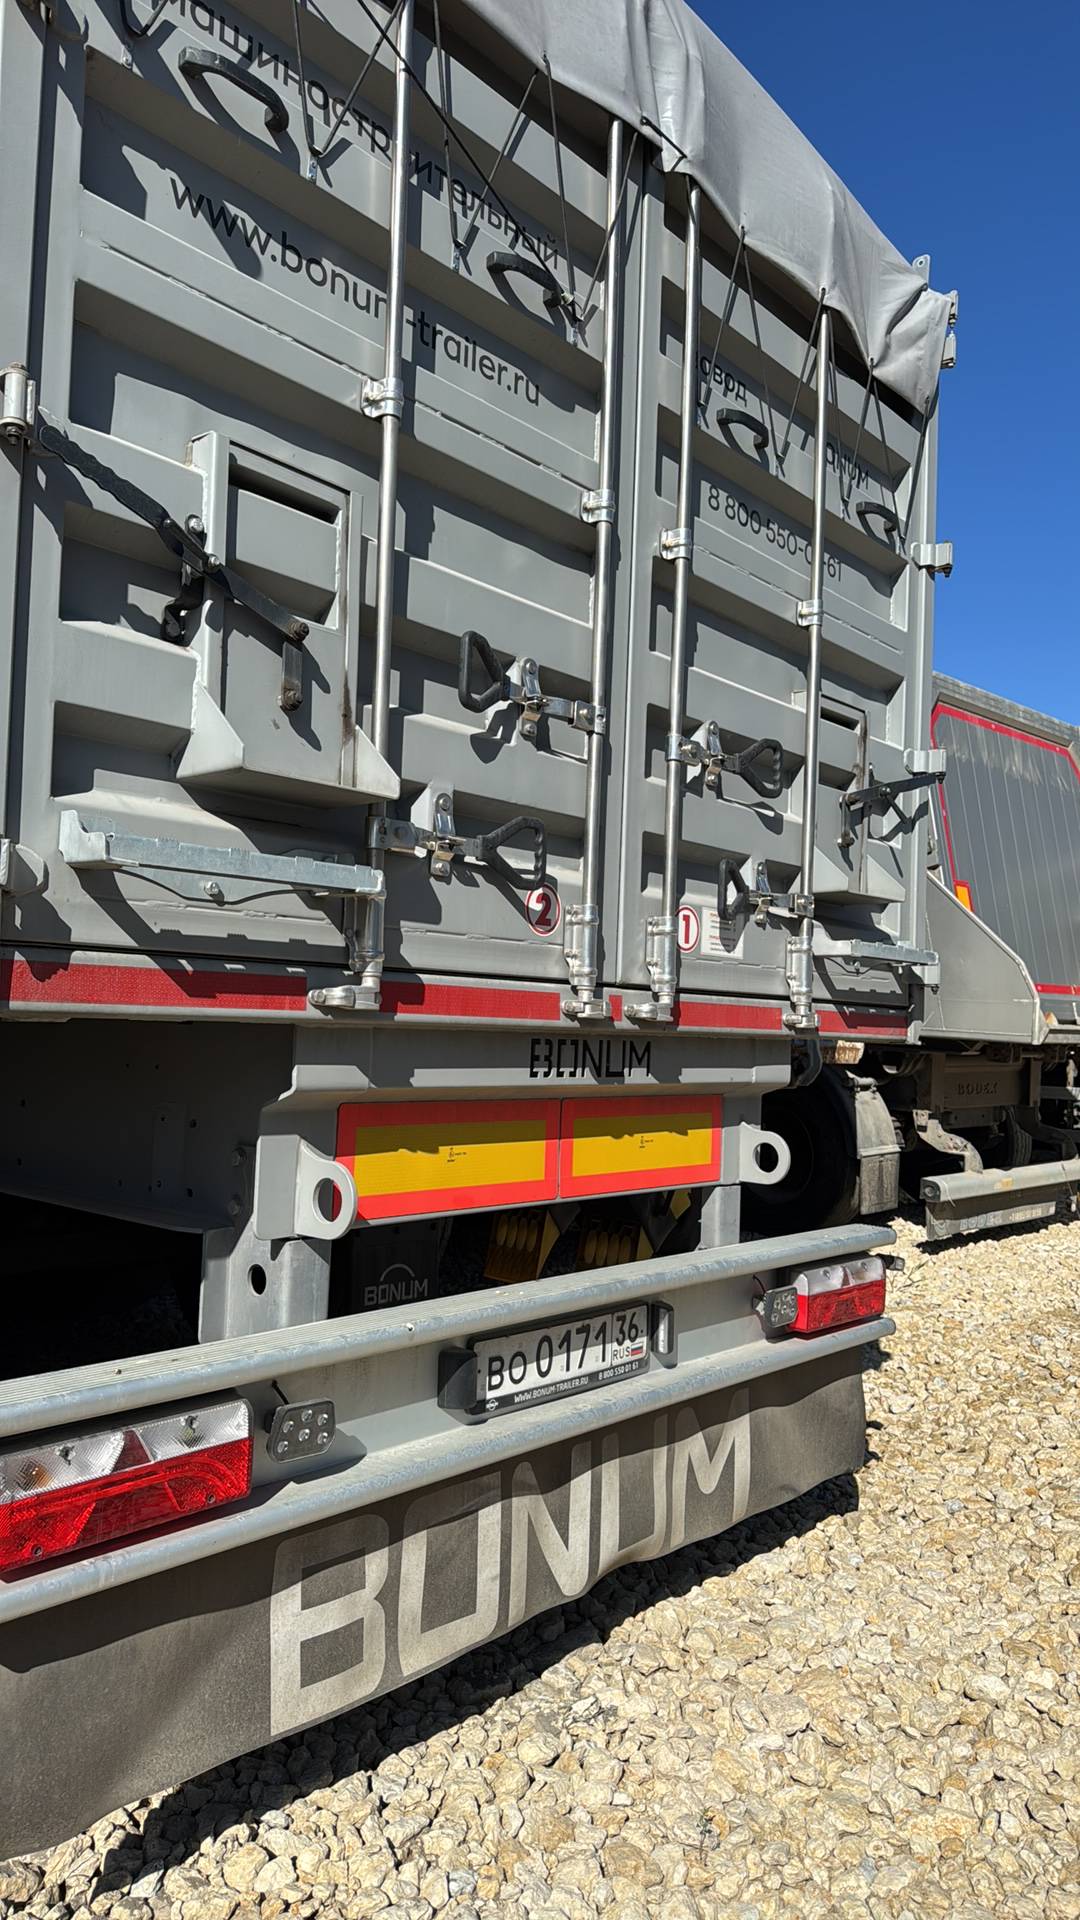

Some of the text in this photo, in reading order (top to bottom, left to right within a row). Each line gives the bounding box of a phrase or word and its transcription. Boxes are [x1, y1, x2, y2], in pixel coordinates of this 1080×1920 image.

[708, 486, 720, 511] 8
[725, 495, 762, 534] 800
[534, 893, 552, 926] 2
[683, 914, 691, 944] 1
[529, 1038, 651, 1078] BONUM
[364, 1278, 428, 1306] BONUM
[536, 1321, 607, 1378] 0171
[615, 1312, 640, 1347] 36
[612, 1346, 630, 1361] RUS
[513, 1376, 589, 1404] WWW.BONUM-TRAILER.RU
[270, 1387, 751, 1736] BONUM
